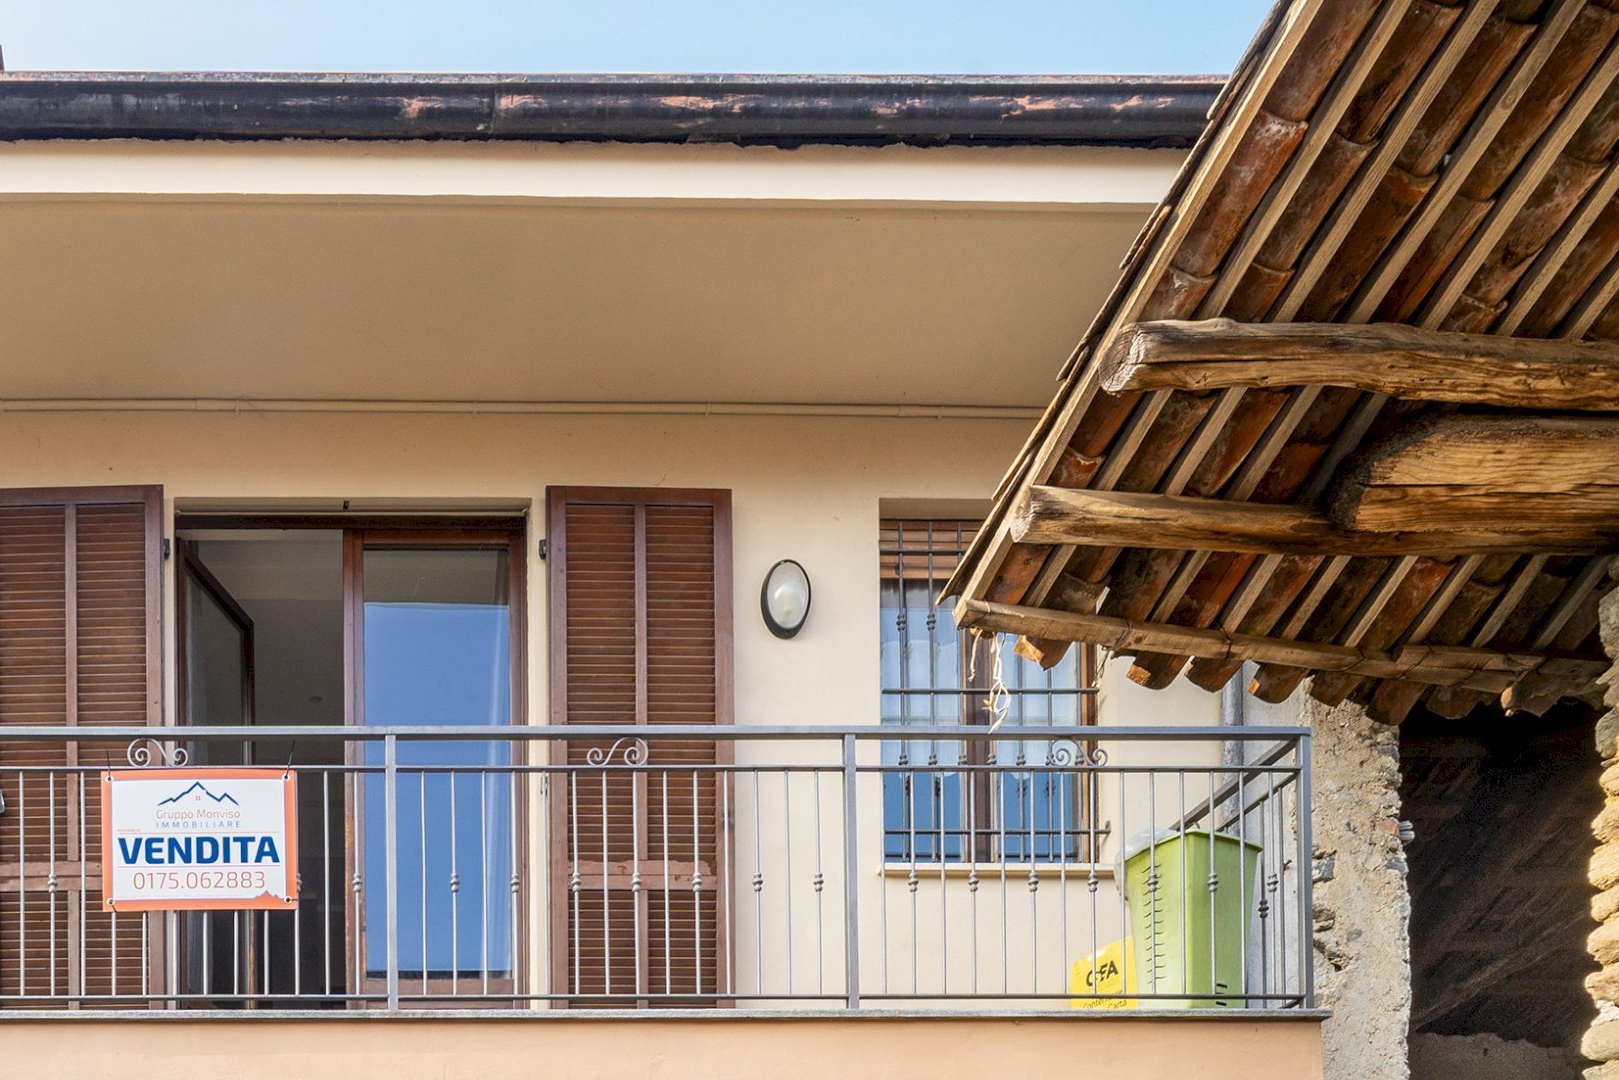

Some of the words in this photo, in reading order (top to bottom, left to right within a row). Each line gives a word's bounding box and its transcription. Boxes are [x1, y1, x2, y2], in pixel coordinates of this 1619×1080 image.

[156, 809, 193, 820] Gruppo
[196, 809, 240, 819] Monviso
[156, 820, 241, 829] IMMOBILIARE
[118, 836, 280, 864] VENDITA
[133, 871, 266, 890] 0175.062883
